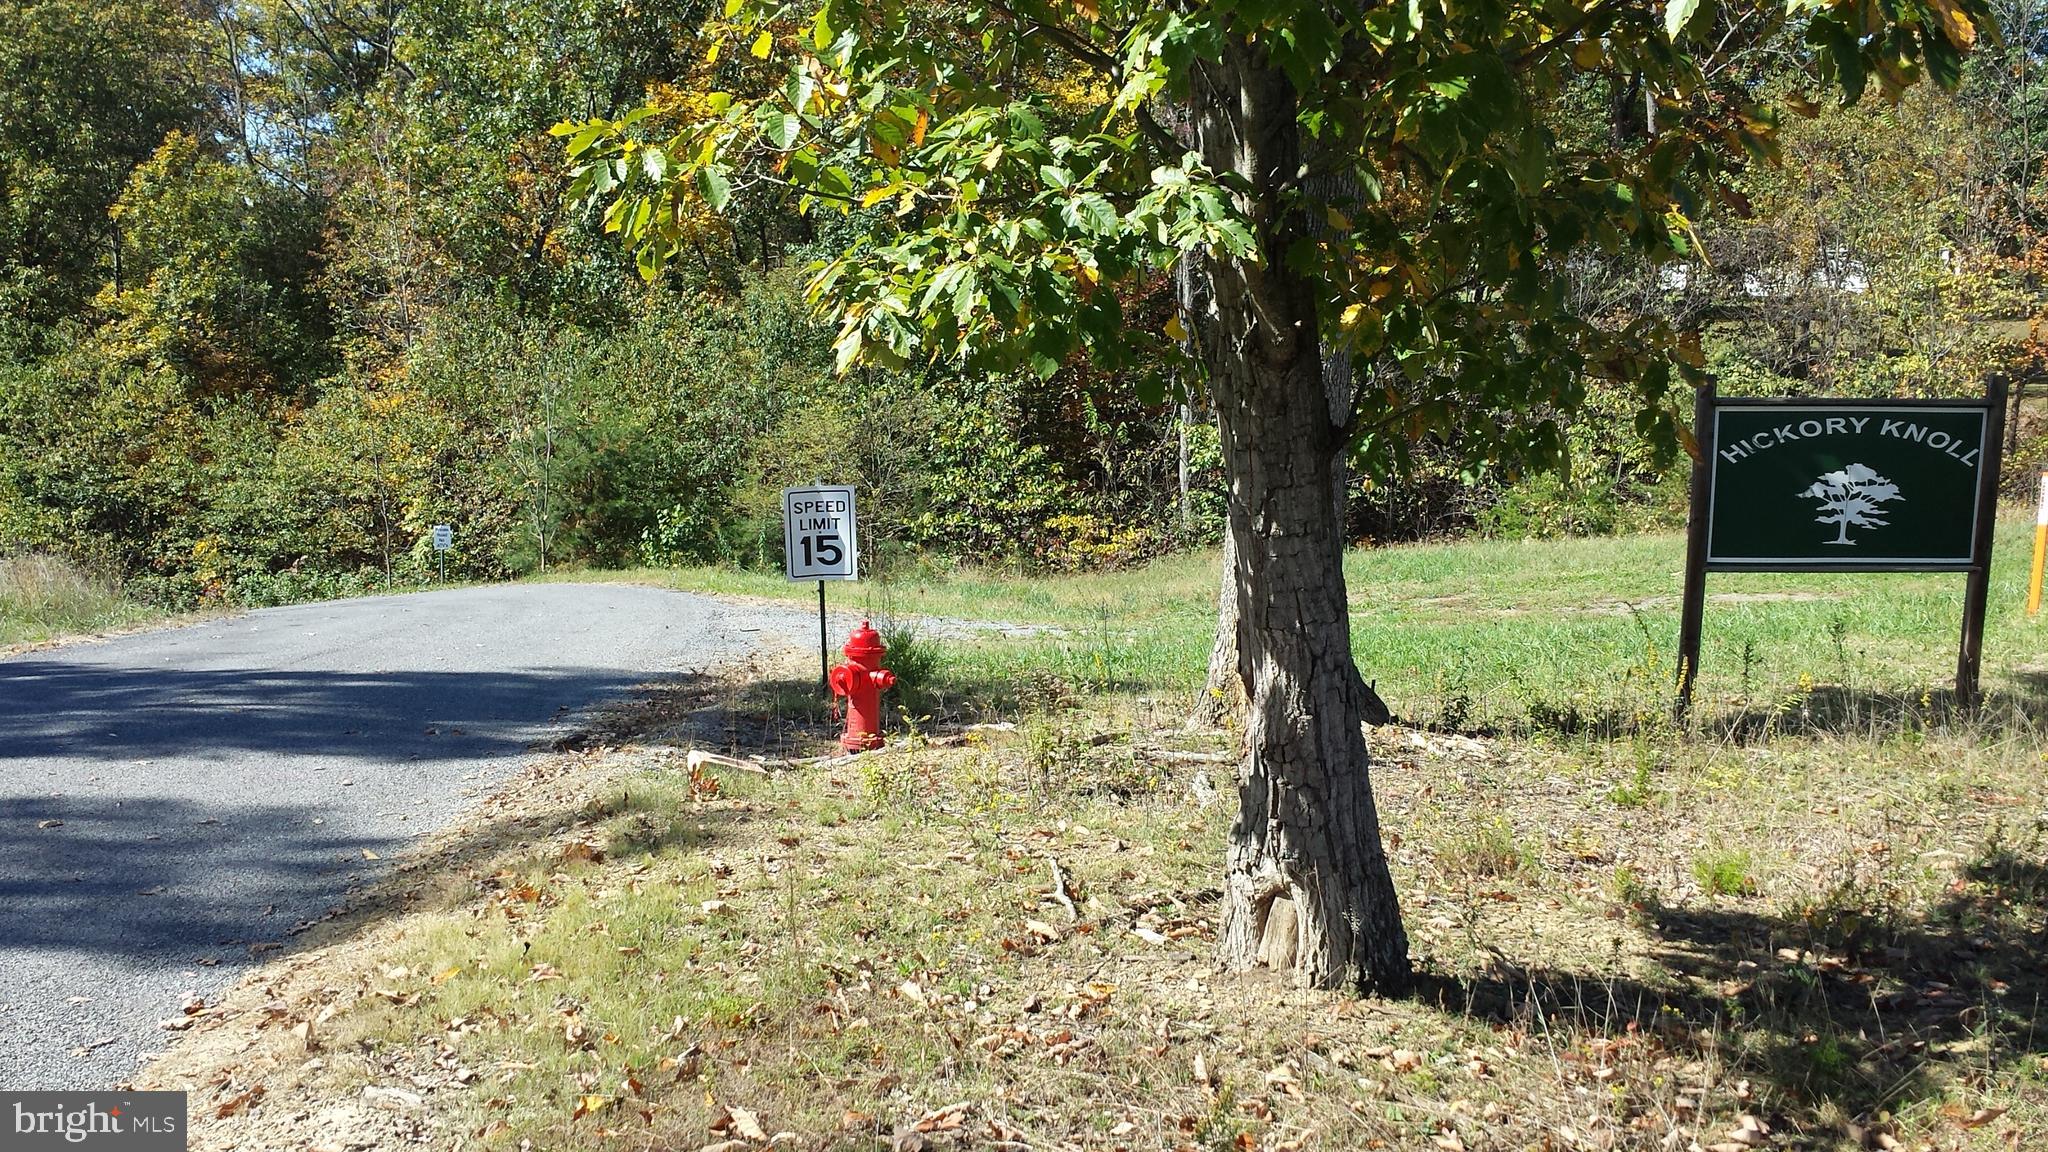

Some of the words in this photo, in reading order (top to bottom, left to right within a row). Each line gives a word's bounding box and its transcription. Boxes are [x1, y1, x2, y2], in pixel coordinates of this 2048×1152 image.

[1719, 417, 1870, 464] HICKORY
[1879, 419, 1980, 467] KNOLL
[794, 500, 846, 514] SPEED
[800, 517, 841, 531] LIMIT
[800, 534, 843, 567] 15
